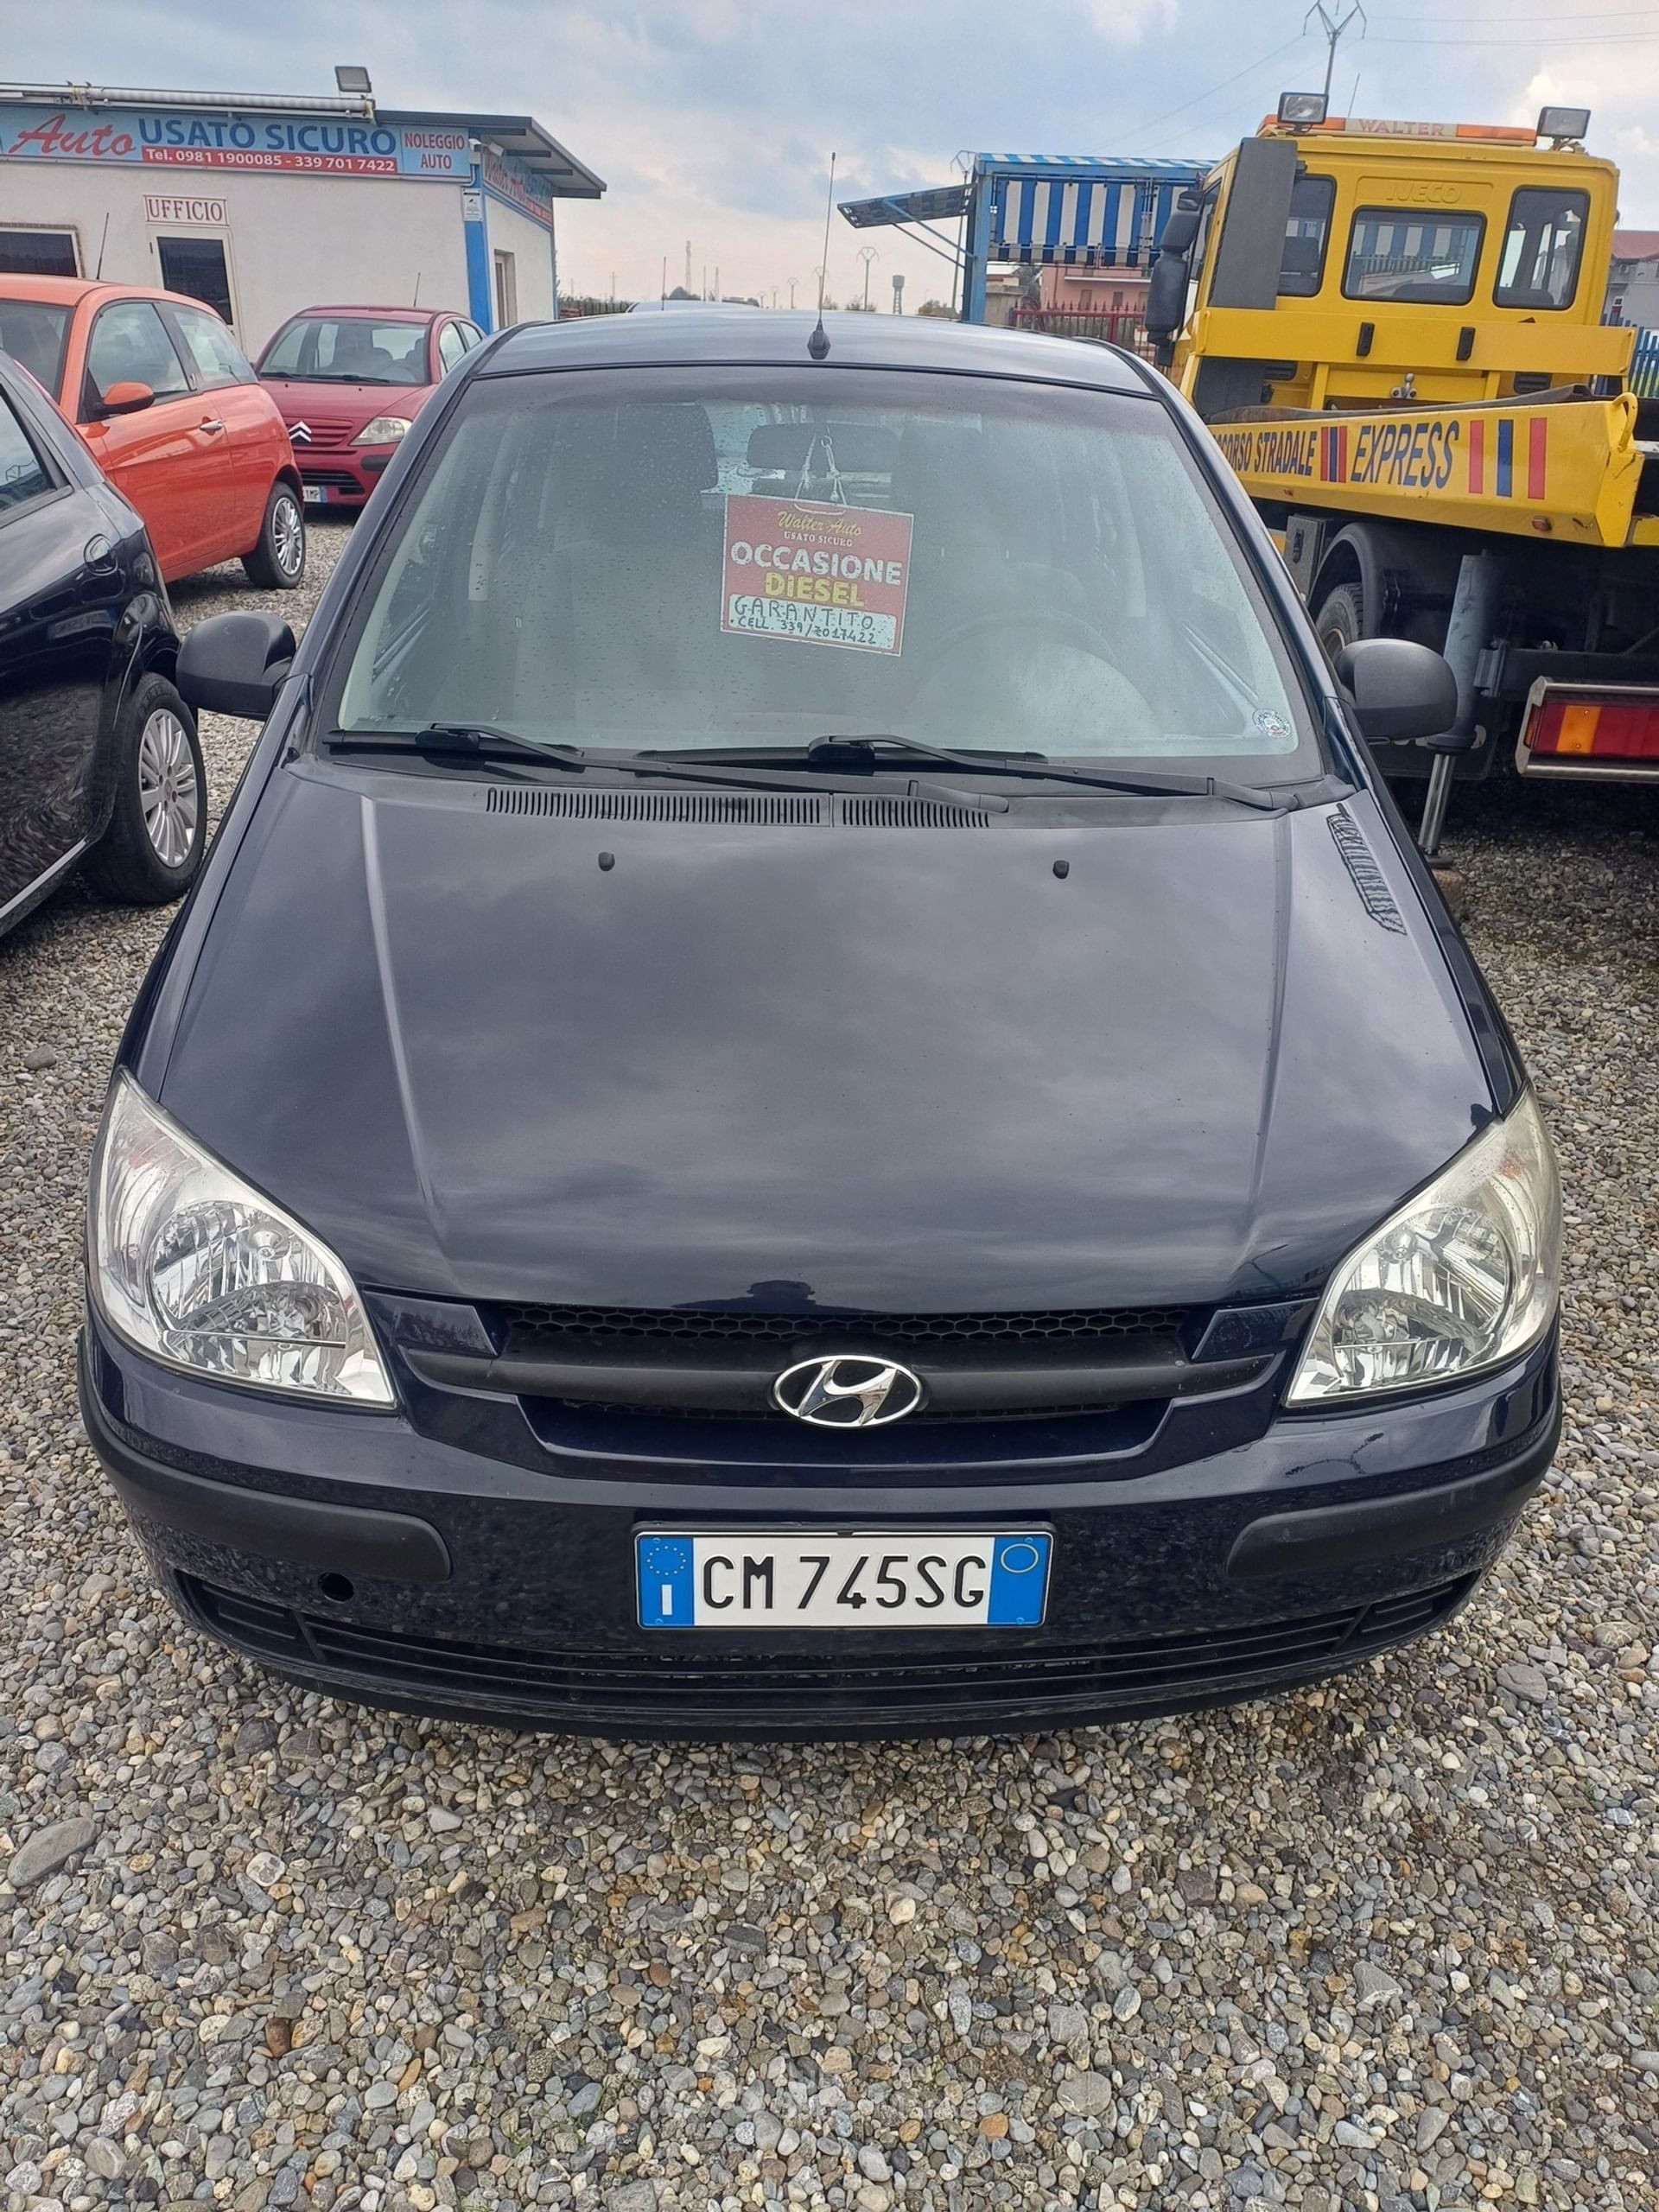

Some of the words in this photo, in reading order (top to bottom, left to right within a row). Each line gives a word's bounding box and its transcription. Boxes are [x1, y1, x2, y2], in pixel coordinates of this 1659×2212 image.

[9, 113, 137, 156] Auto
[138, 118, 256, 148] USATO
[265, 124, 397, 155] SICURO
[1358, 119, 1446, 137] WALTER
[404, 133, 465, 149] NOLEGGIO
[146, 149, 173, 161] Tel.
[175, 150, 213, 162] 0981
[217, 152, 283, 166] 1900085
[295, 156, 323, 168] 339
[327, 157, 353, 169] 701
[357, 159, 395, 172] 7422
[420, 153, 452, 169] AUTO
[1385, 181, 1460, 204] IVECO
[148, 198, 223, 221] UFFICIO
[1255, 430, 1318, 476] STRADALE
[1350, 419, 1459, 489] EXPRESS
[777, 511, 825, 531] Walter
[826, 517, 862, 536] Auto
[784, 531, 816, 543] USATO
[817, 535, 853, 547] SICURO
[730, 541, 903, 586] OCCASIONE
[765, 572, 865, 607] DIESEL
[702, 1555, 774, 1609] CM
[797, 1555, 986, 1609] 745SG
